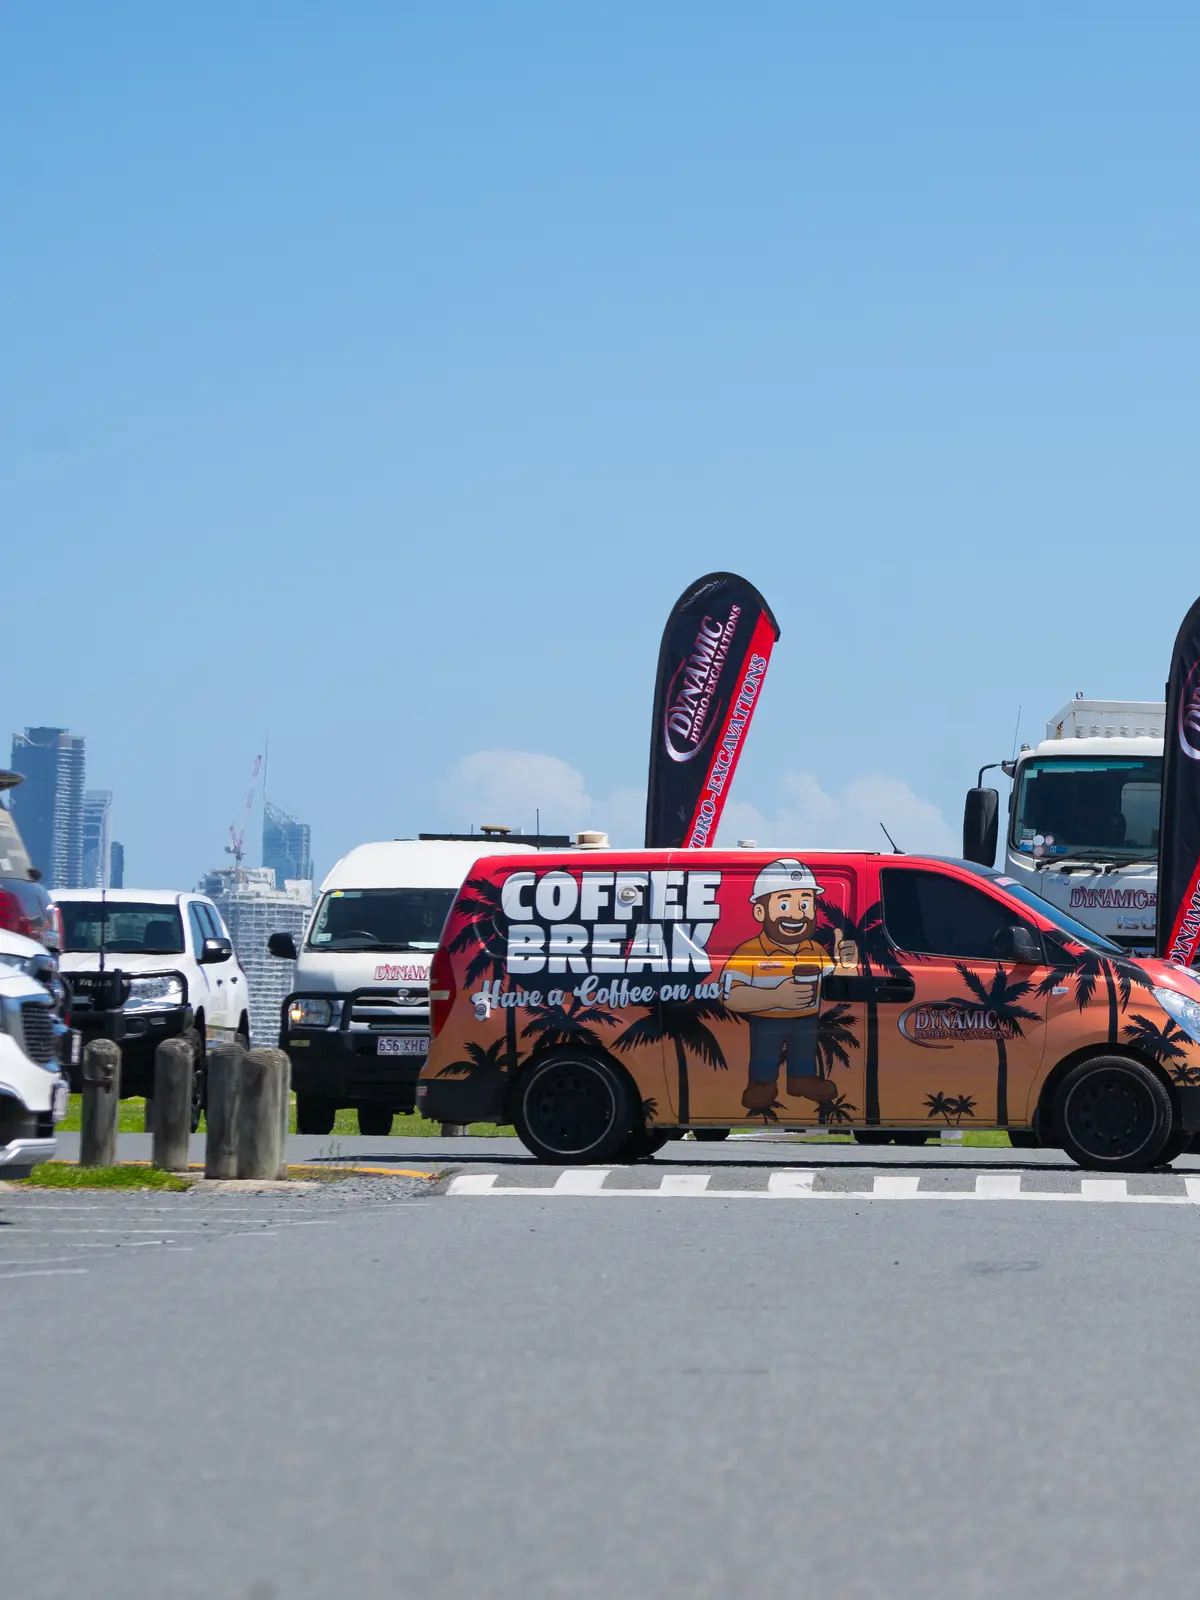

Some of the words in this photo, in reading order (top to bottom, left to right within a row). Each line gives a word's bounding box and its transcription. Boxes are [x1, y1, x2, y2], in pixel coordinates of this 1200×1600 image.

[668, 615, 724, 740] DYNAMIC
[690, 604, 742, 746] HYDRO-EXCAVATIONS
[688, 654, 767, 848] DRO-EXCAVATIONS
[501, 870, 722, 921] COFFEE
[1069, 886, 1147, 909] DYNAMIC
[1116, 915, 1156, 930] ISU
[506, 923, 713, 974] BREAK
[374, 964, 431, 981] DYNAM
[470, 979, 543, 1009] Have
[548, 987, 566, 1006] a
[573, 975, 655, 1009] Coffee
[659, 983, 691, 1001] on
[694, 973, 733, 1000] us!
[914, 1006, 998, 1030] DYNAMIC
[914, 1029, 1014, 1040] HYDRO-EXCAVATIONS
